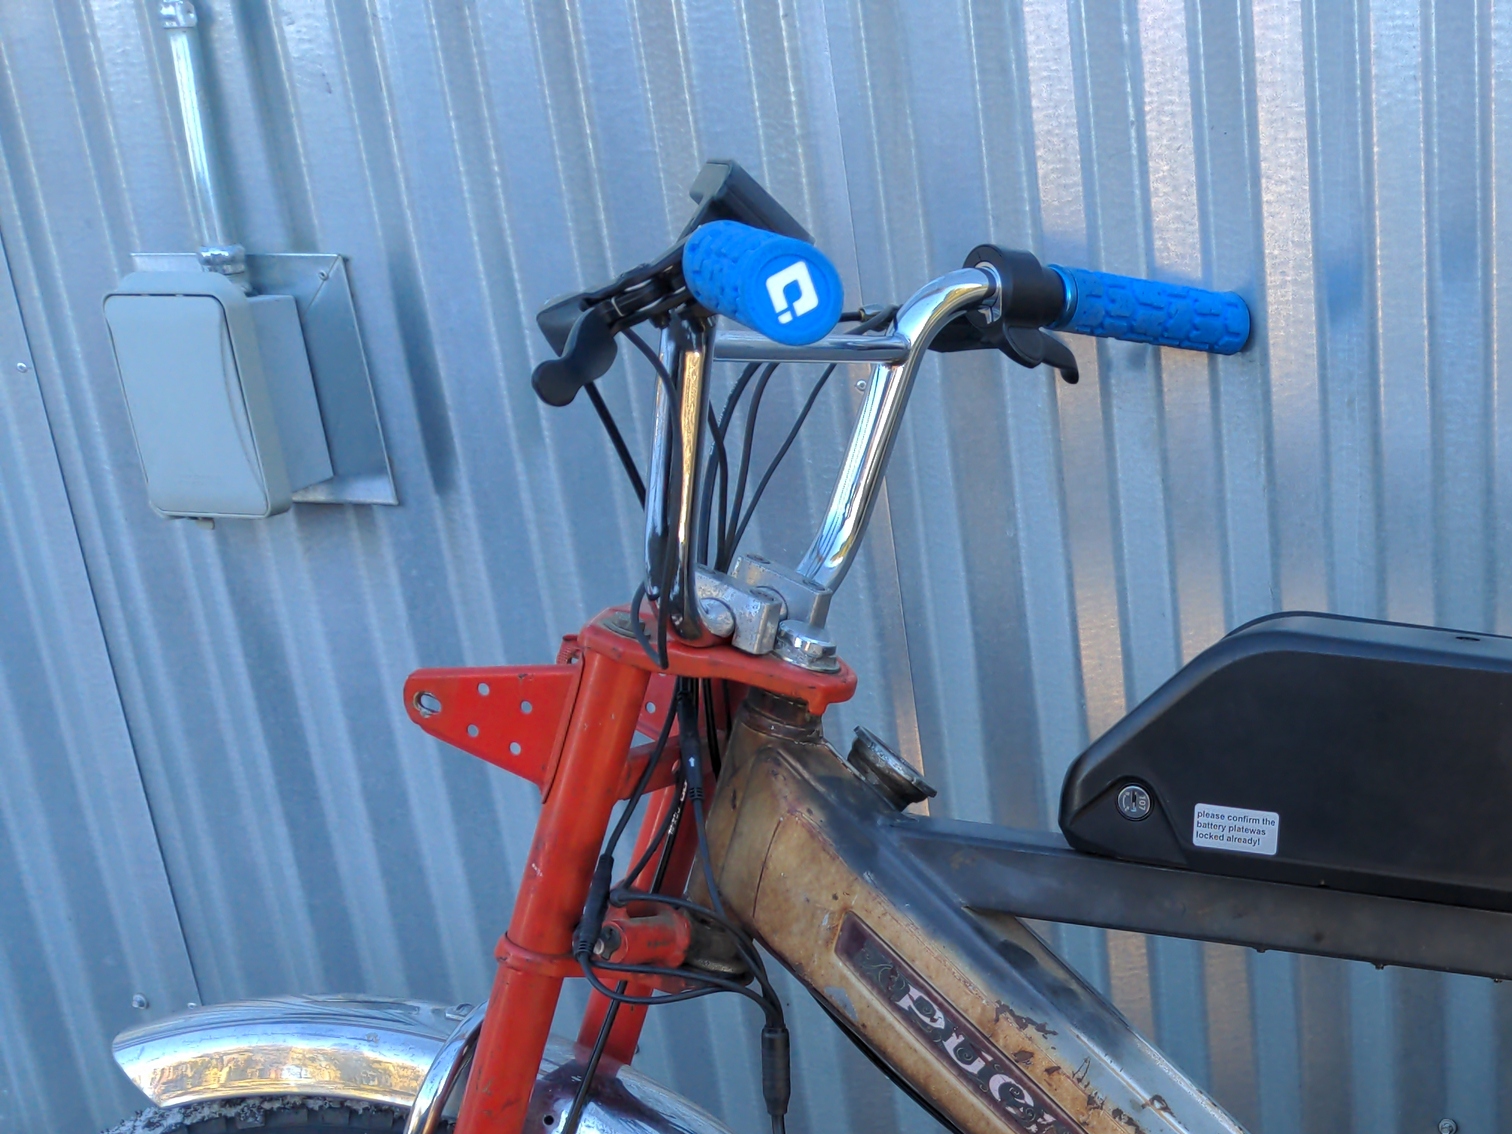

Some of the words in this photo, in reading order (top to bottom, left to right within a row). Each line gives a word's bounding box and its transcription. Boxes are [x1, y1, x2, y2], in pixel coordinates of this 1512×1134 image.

[1197, 811, 1225, 820] please
[1227, 814, 1260, 825] confirm
[1262, 817, 1276, 827] the
[1196, 820, 1227, 832] battery
[1228, 824, 1266, 836] platewas
[1196, 830, 1225, 841] locked
[1226, 835, 1261, 847] already!
